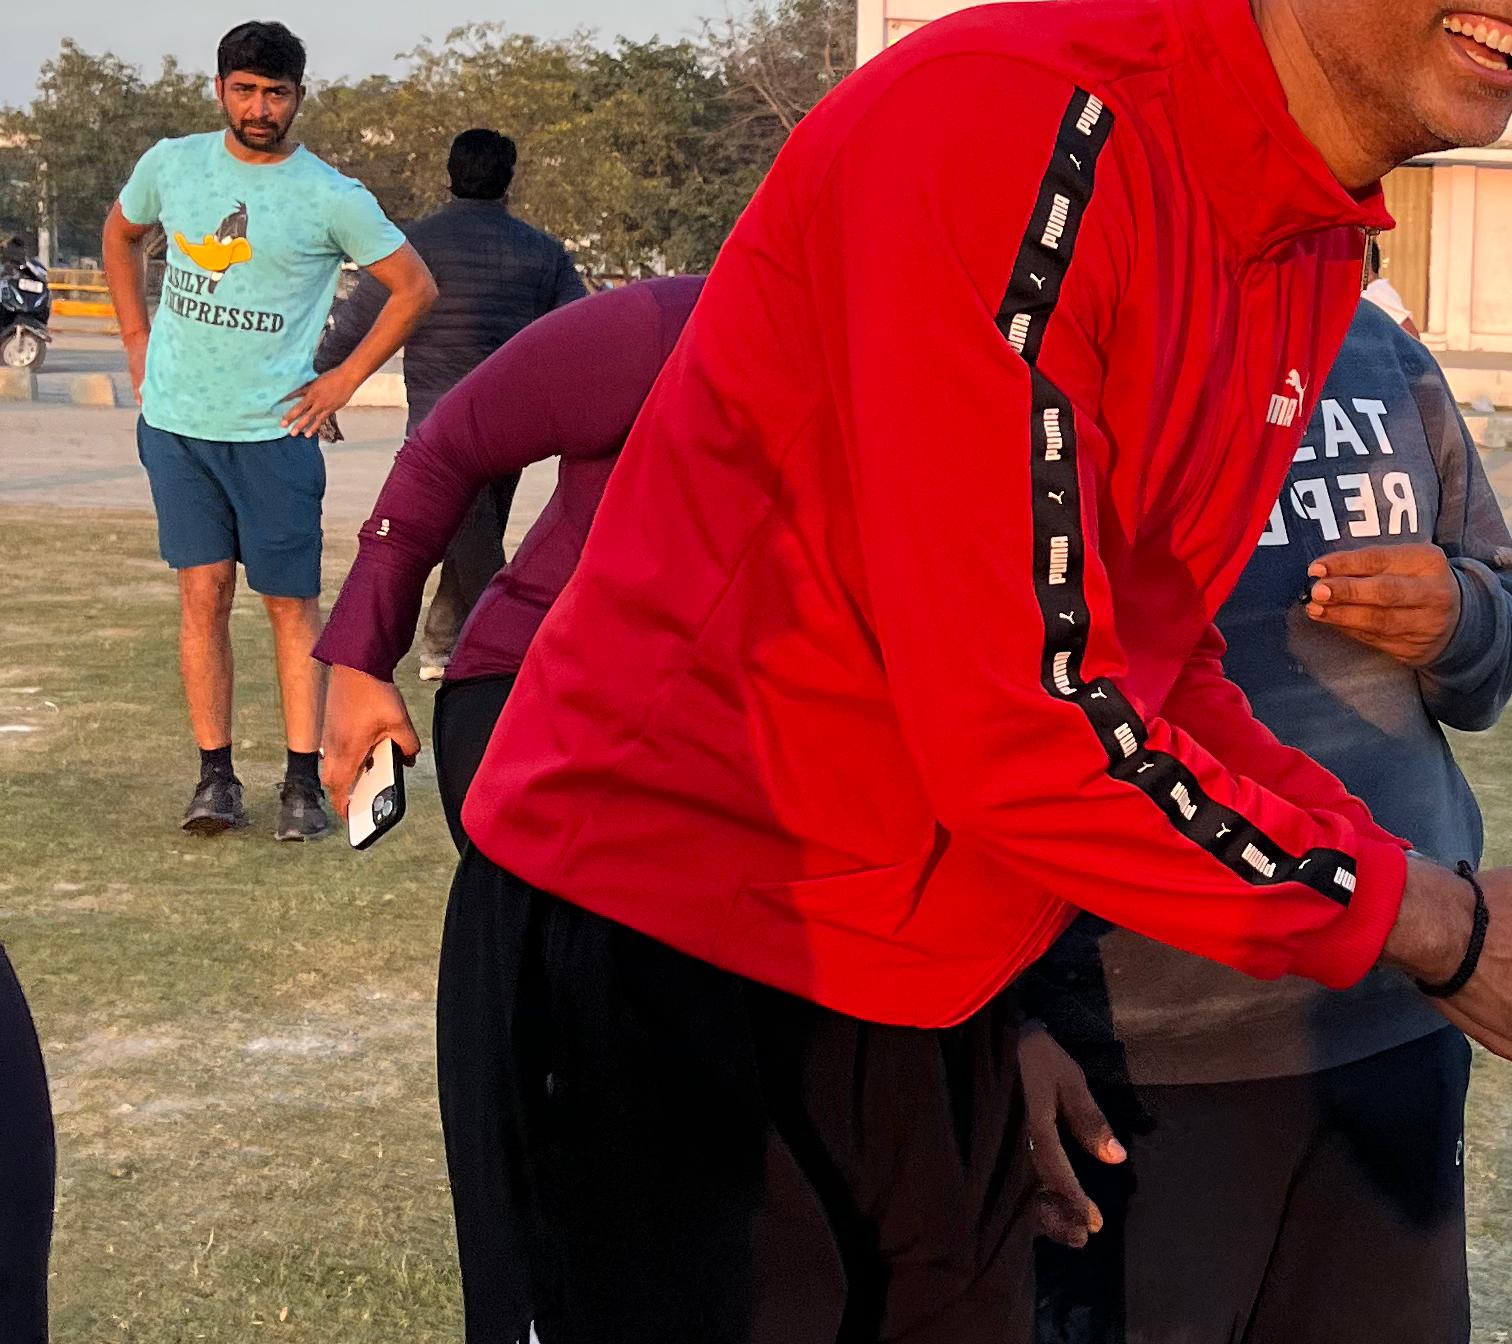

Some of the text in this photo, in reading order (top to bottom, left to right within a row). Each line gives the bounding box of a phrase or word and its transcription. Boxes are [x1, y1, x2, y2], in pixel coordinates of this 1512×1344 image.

[1075, 93, 1104, 136] PUM
[1040, 192, 1070, 250] PUMA
[1008, 312, 1032, 355] UMA
[1043, 407, 1062, 462] PUMA
[1048, 535, 1069, 585] PUMA
[1052, 651, 1078, 696] PUMA
[1241, 842, 1277, 878] PUMA
